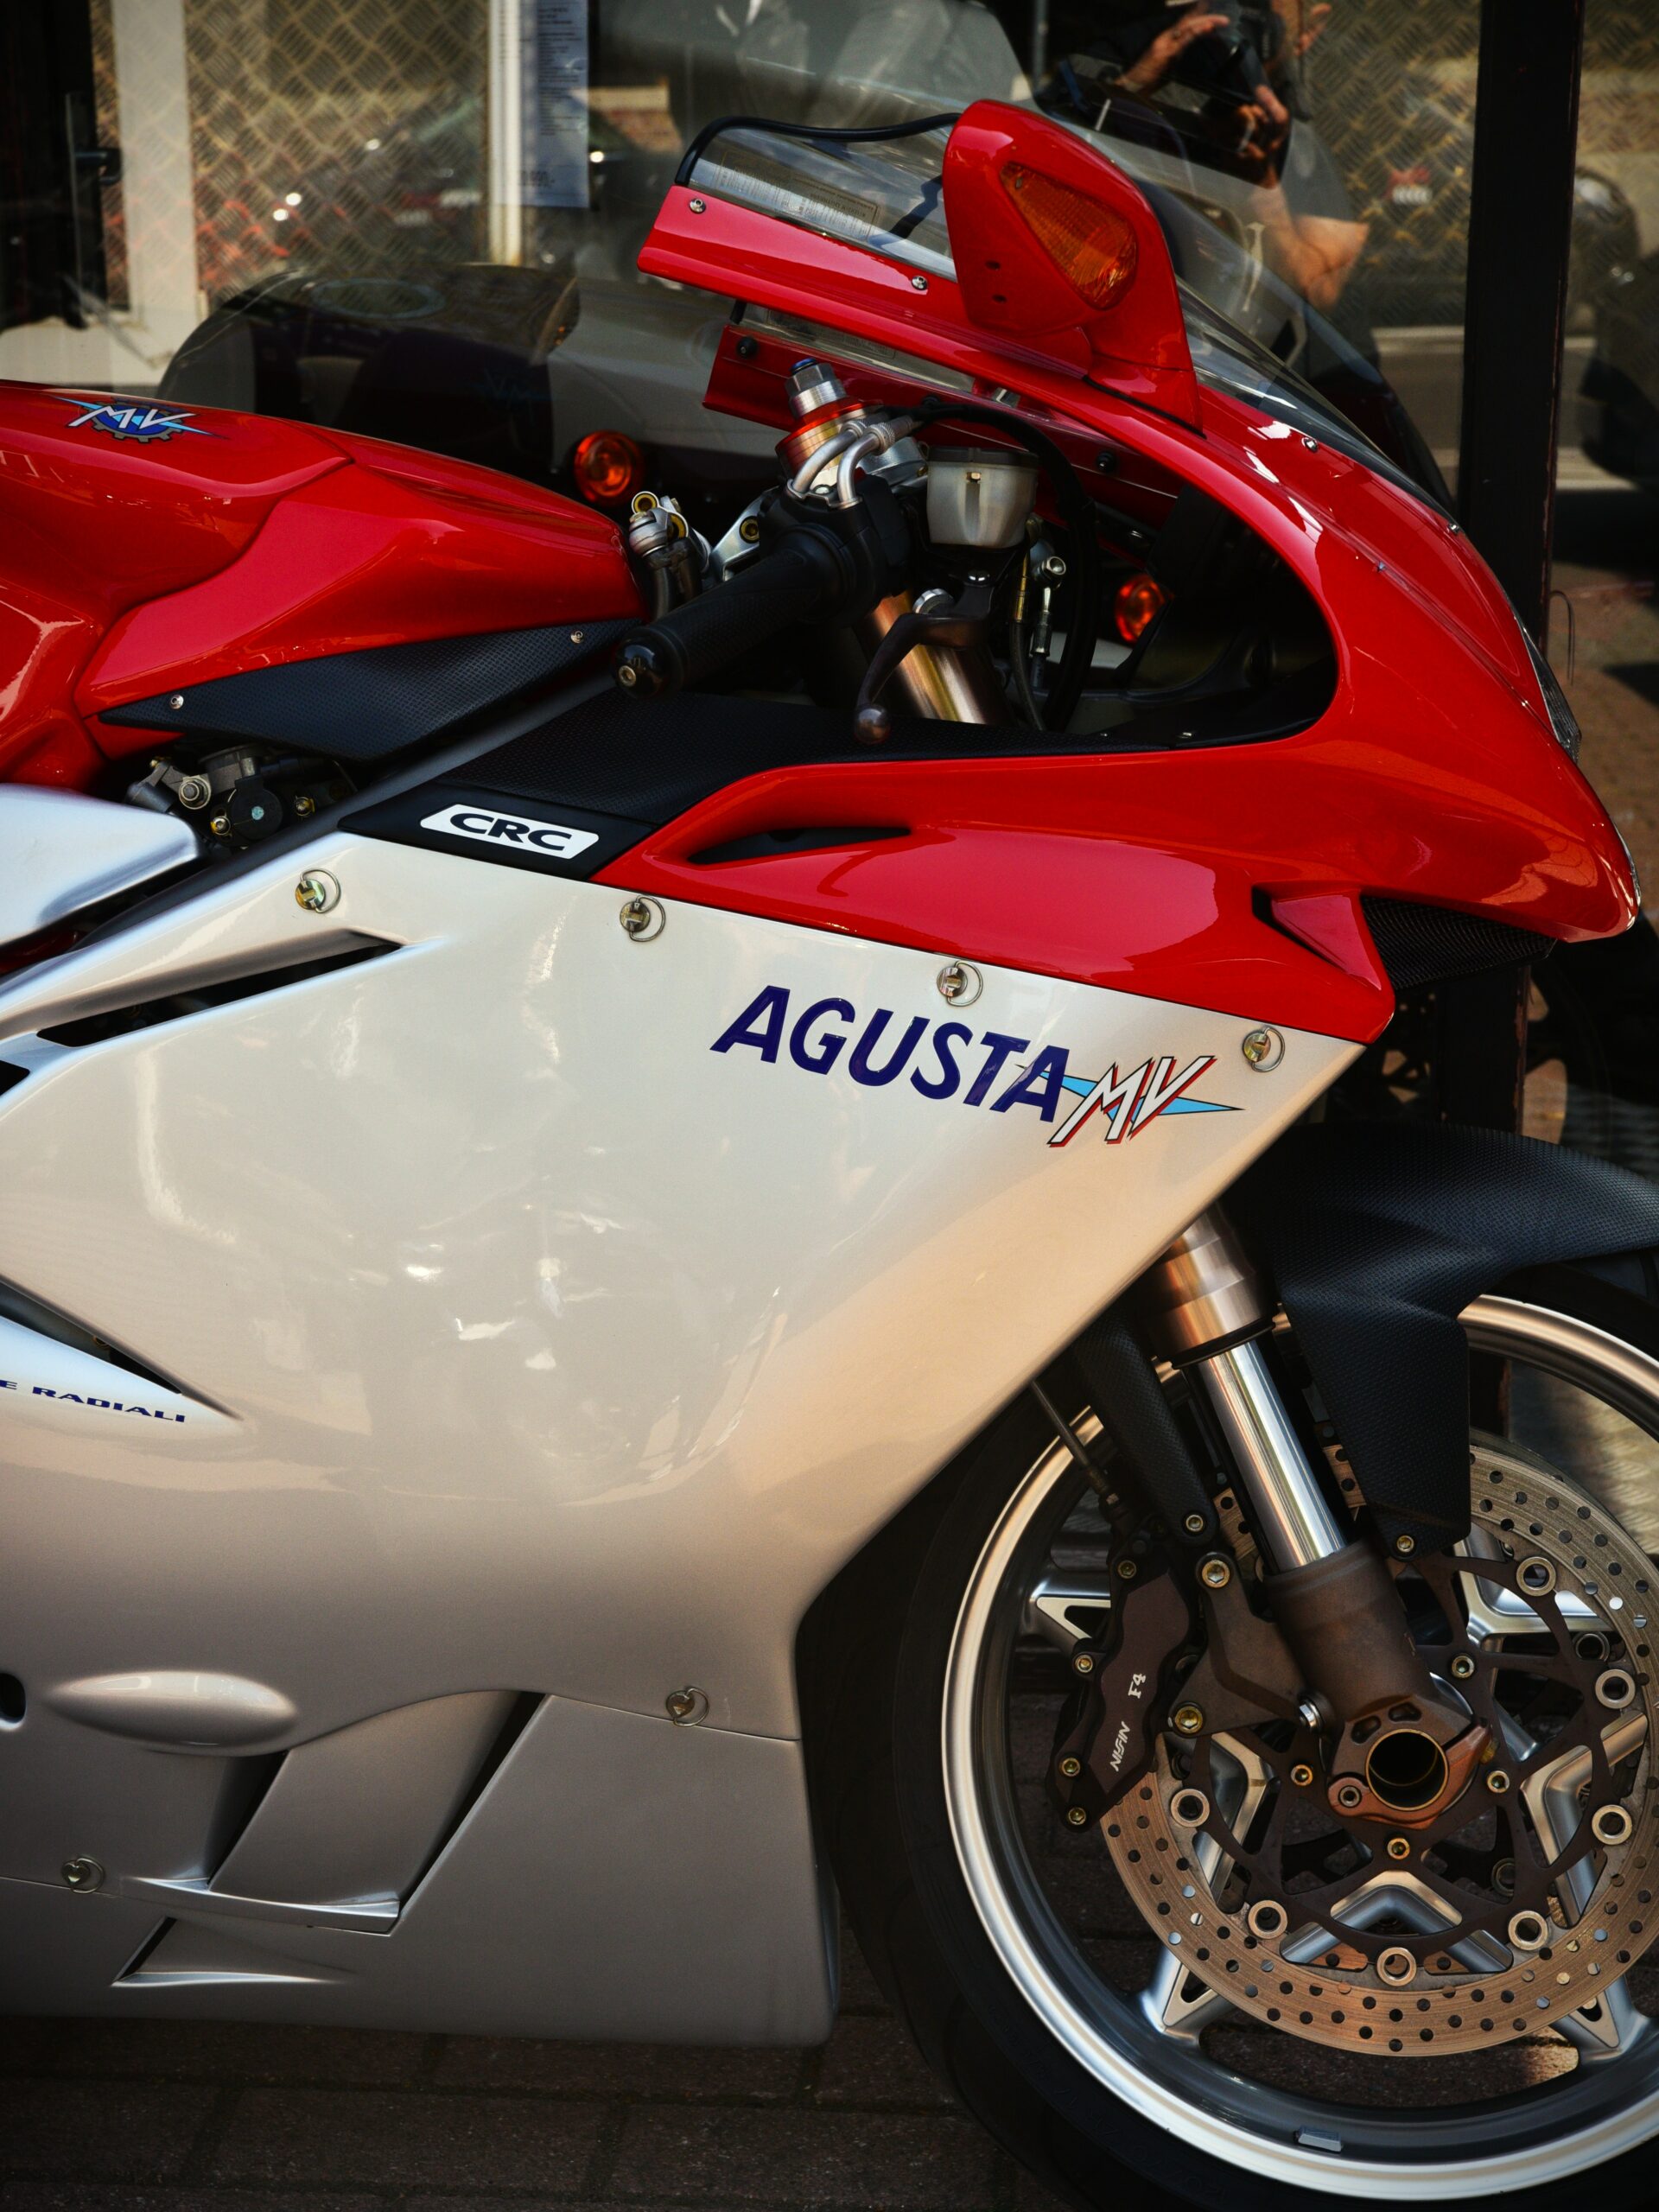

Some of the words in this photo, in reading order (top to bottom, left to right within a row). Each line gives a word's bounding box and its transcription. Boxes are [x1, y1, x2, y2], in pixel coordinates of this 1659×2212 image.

[66, 404, 199, 430] MV
[449, 812, 573, 852] CRC
[709, 984, 1071, 1123] AGUSTA
[1046, 1054, 1218, 1148] MV
[32, 1386, 186, 1423] RADIALI
[1109, 1720, 1131, 1773] NISSIN
[1128, 1673, 1147, 1700] F4
